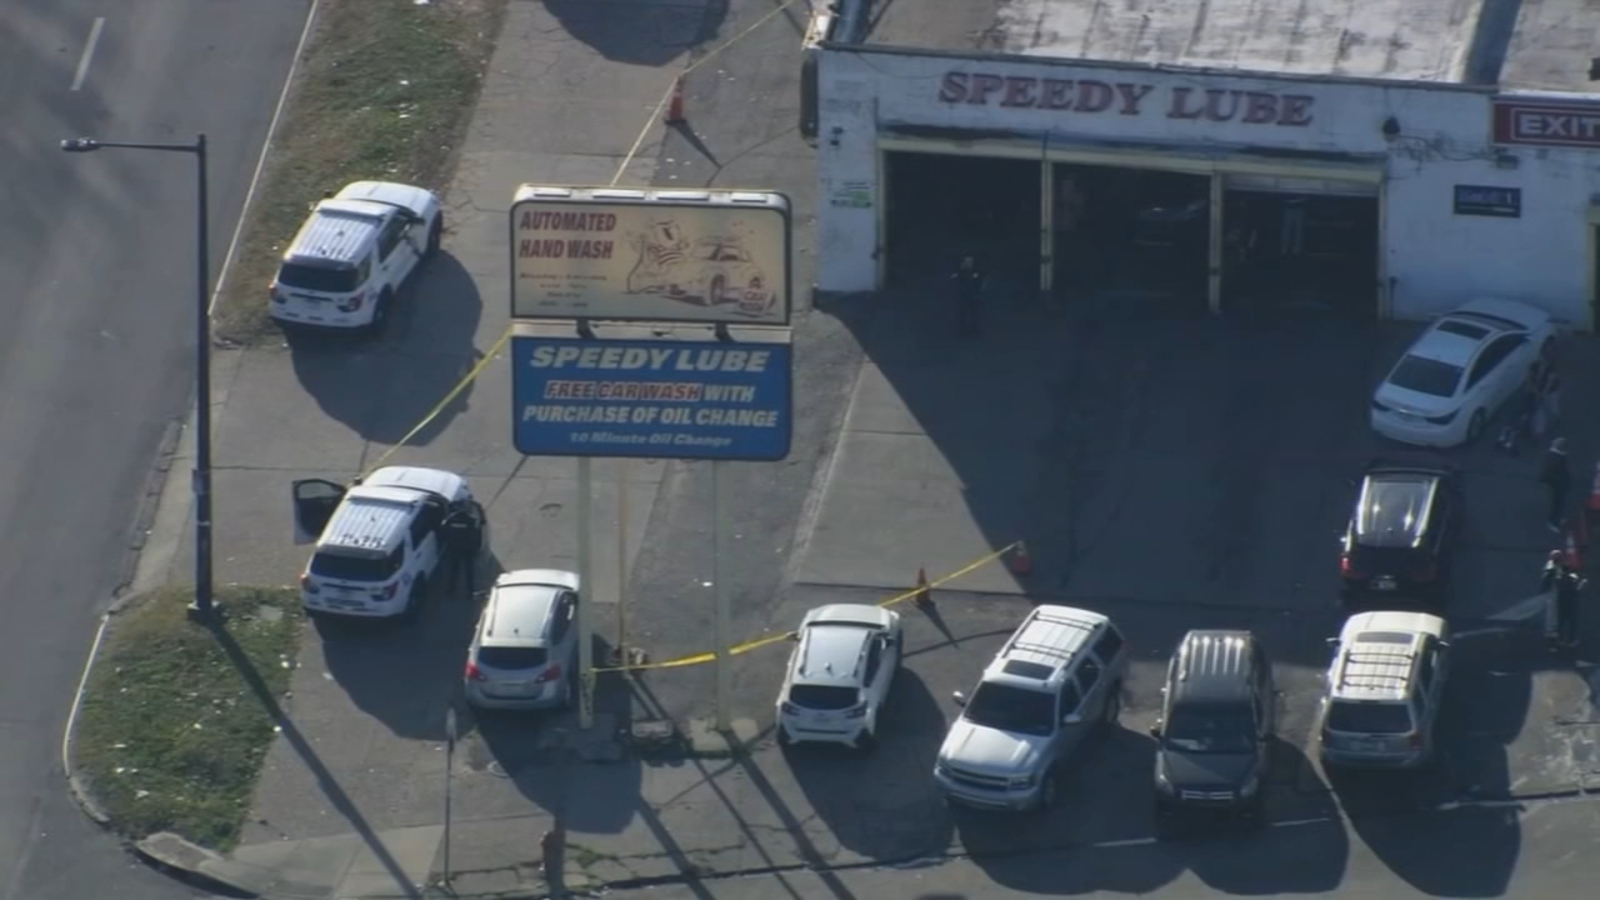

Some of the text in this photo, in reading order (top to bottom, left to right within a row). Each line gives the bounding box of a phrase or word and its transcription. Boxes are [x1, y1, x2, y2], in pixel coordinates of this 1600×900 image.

[938, 71, 1315, 127] SPEEDY LUBE
[1519, 113, 1600, 138] EXIT
[519, 211, 616, 232] AUTOMATED
[519, 239, 614, 260] HAND WASH
[529, 346, 771, 372] SPEEDY LUBE
[544, 380, 756, 403] FREE CAR WASH WITH
[523, 404, 779, 427] PURCHASE OF OIL CHANGE
[590, 432, 646, 444] Minute
[649, 433, 673, 445] Oil
[674, 433, 732, 448] Change
